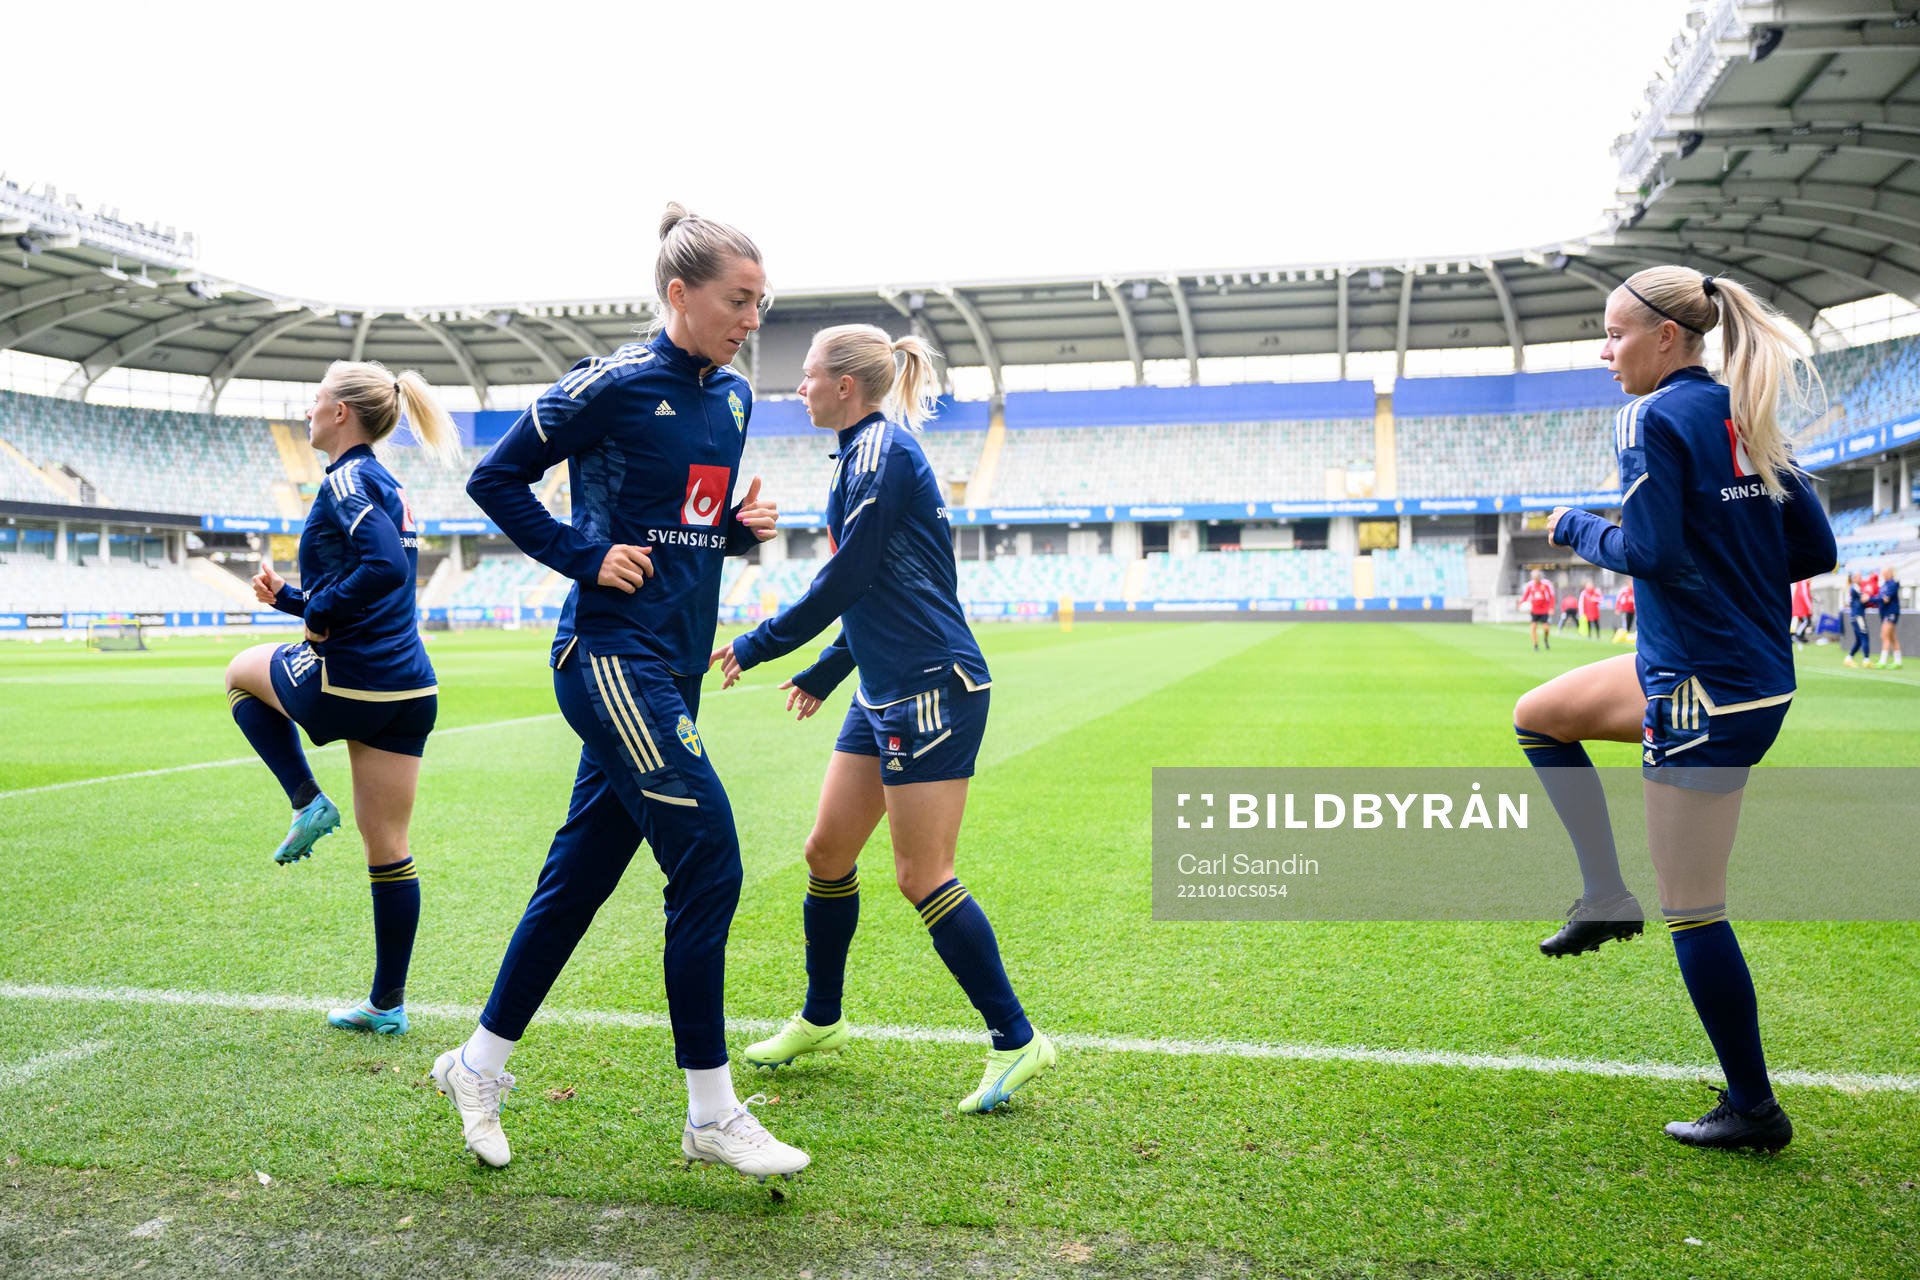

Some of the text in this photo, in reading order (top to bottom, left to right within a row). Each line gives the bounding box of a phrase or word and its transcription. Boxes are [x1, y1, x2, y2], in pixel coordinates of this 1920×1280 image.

[1720, 483, 1768, 501] SVENSK
[647, 529, 727, 549] SVENSKA SP
